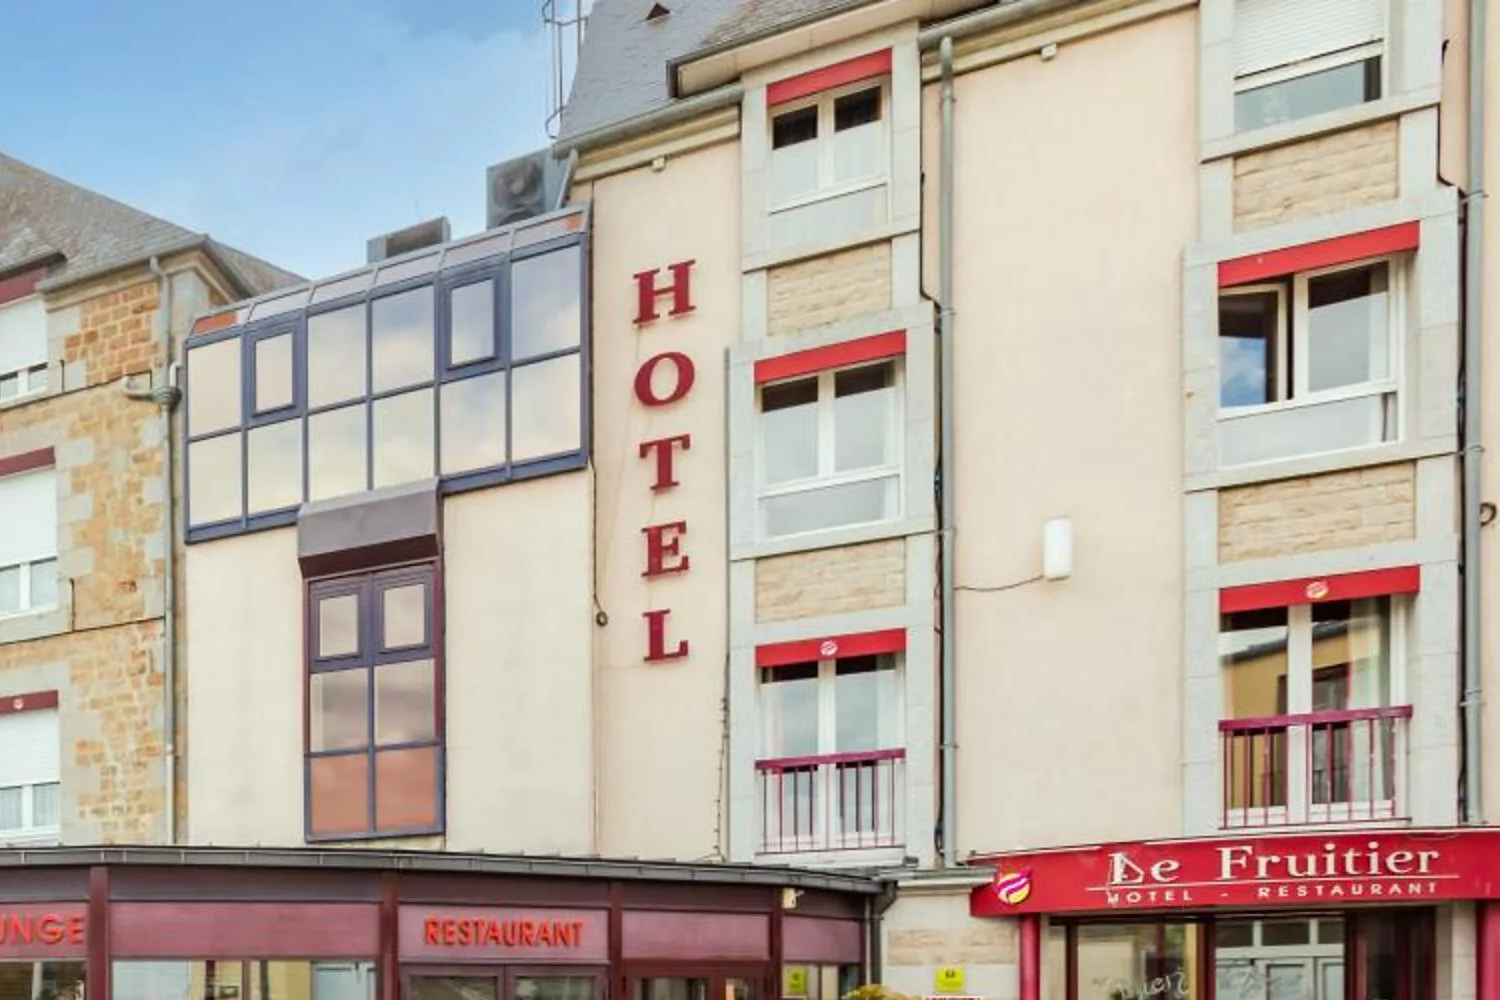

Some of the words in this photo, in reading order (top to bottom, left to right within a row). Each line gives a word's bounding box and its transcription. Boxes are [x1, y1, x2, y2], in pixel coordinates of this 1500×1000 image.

[632, 259, 697, 664] HOTEL
[1108, 852, 1180, 884] Le
[1214, 841, 1440, 880] Fruitier
[1108, 889, 1193, 904] HOTEL
[1257, 882, 1437, 898] RESTAURANT
[425, 917, 583, 946] RESTAURANT
